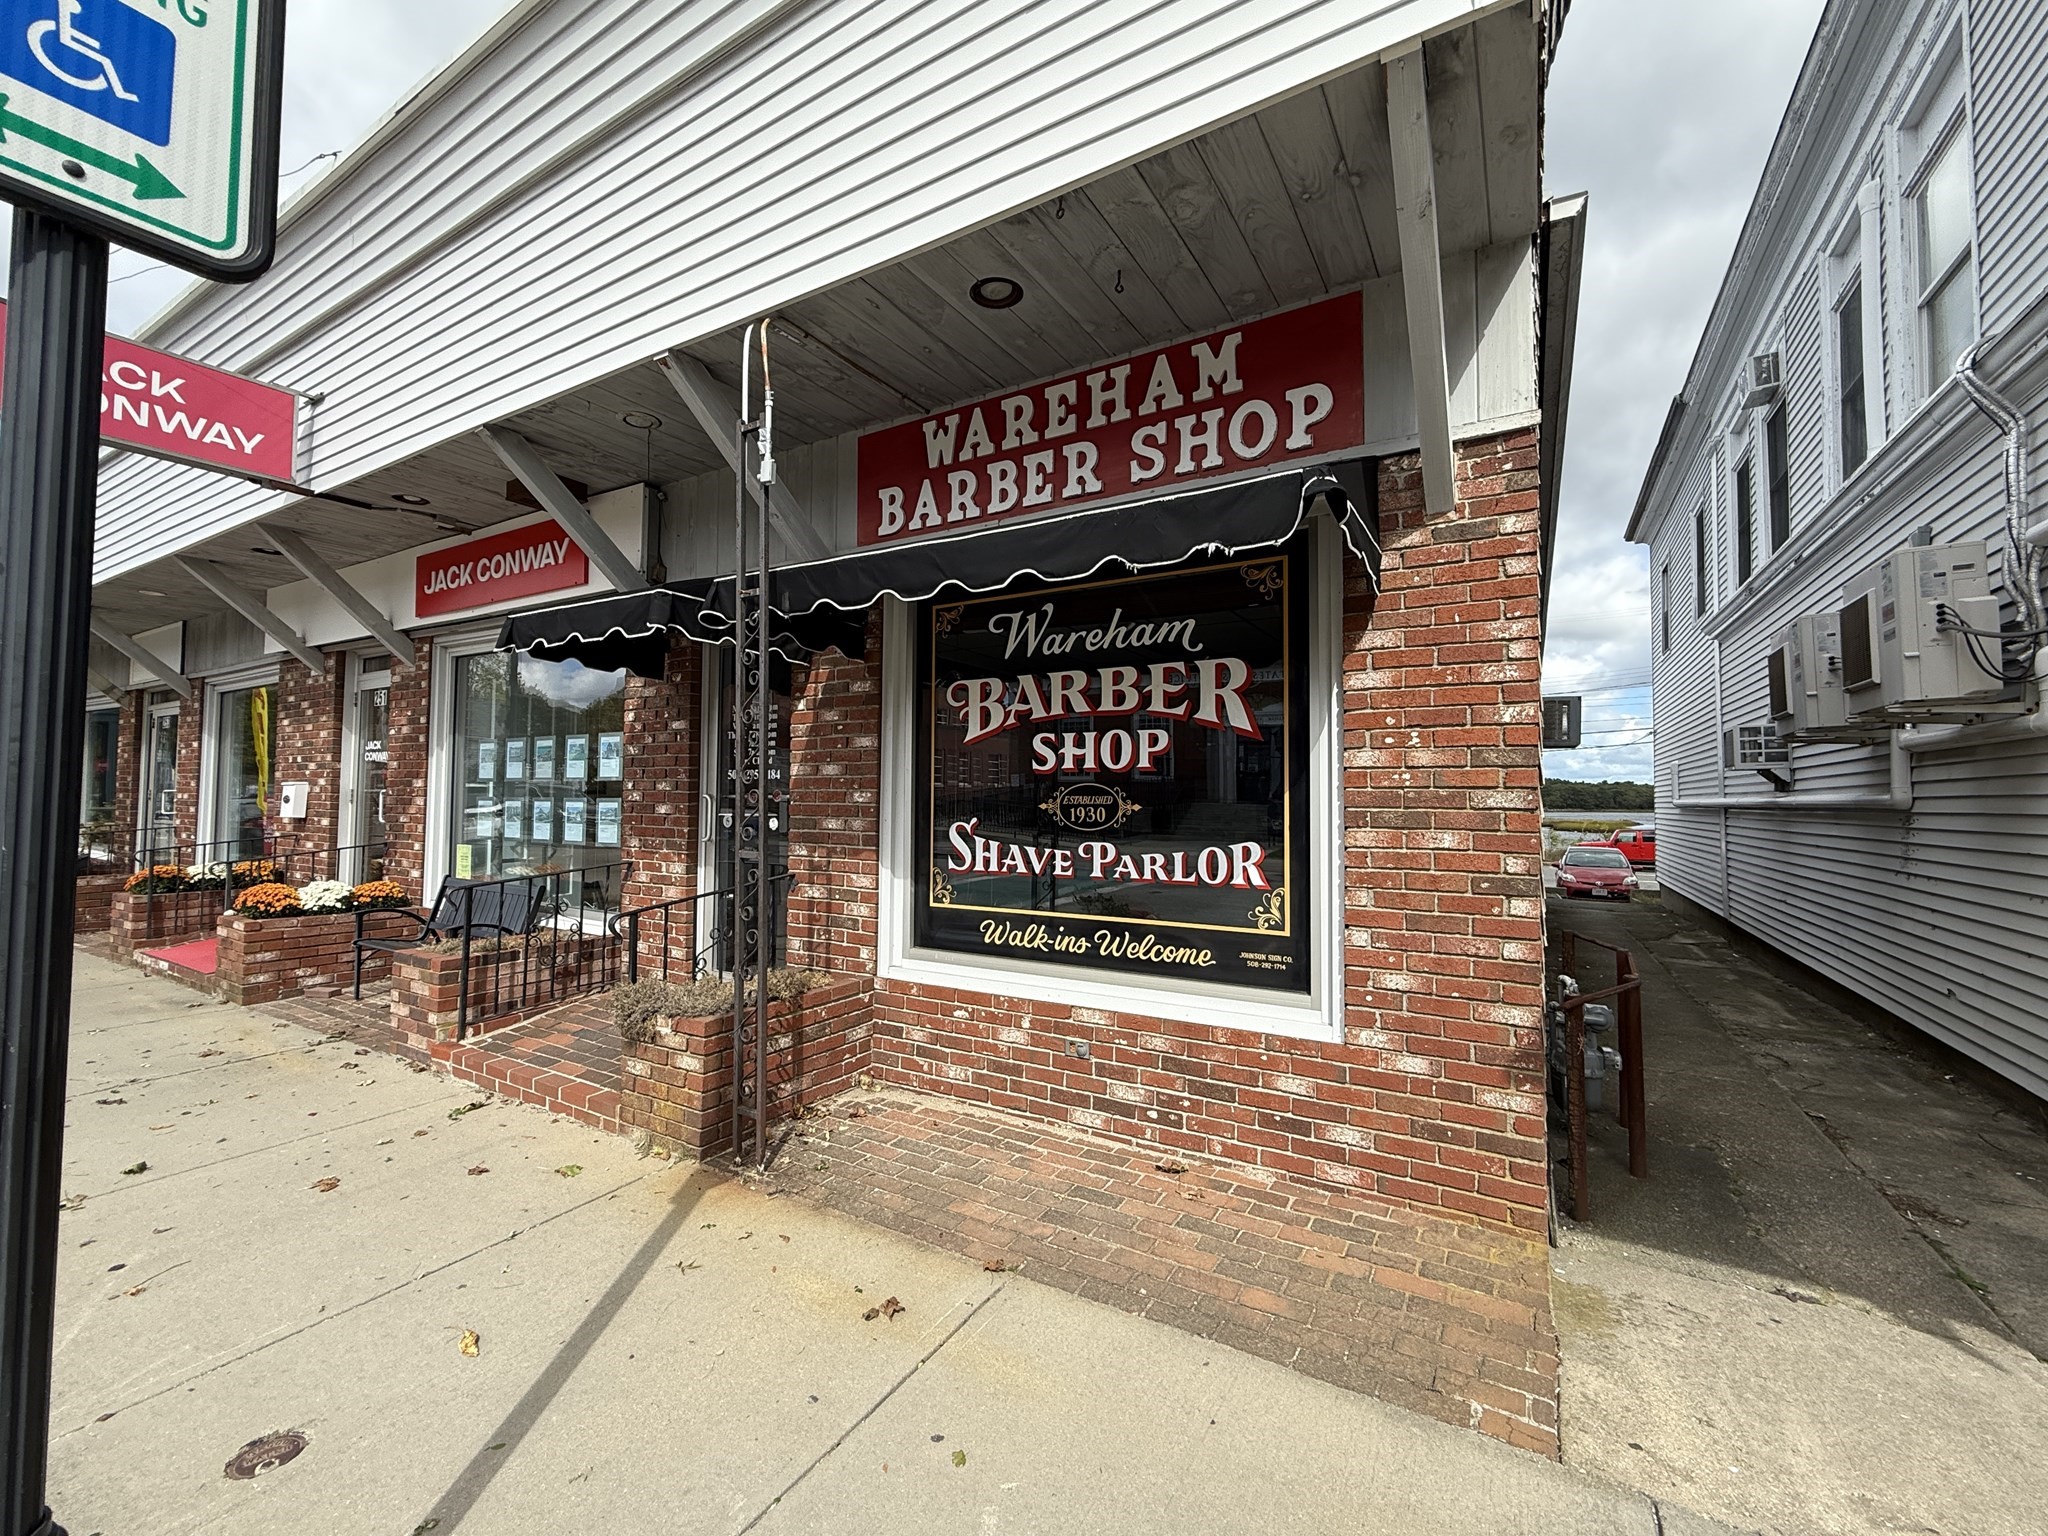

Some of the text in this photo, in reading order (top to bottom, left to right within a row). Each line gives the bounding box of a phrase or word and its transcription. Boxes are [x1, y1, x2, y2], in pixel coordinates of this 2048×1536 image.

[102, 361, 187, 404] CK
[922, 331, 1244, 469] WAREHAM
[100, 394, 266, 455] NWAY
[877, 382, 1335, 536] BARBER SHOP
[424, 537, 571, 595] JACK CONWAY
[988, 602, 1205, 660] Wareham
[375, 691, 387, 706] 251
[946, 656, 1264, 744] BARBER
[365, 741, 382, 751] JACK
[1032, 729, 1172, 774] SHOP
[1062, 795, 1114, 806] ESTABLISHED
[1069, 806, 1106, 824] 1930
[948, 817, 1272, 890] SHAVE PARLOR
[979, 919, 1217, 968] Walk-ins Welcome
[1239, 952, 1267, 961] JOHNSON
[1267, 954, 1282, 962] SIGN
[1247, 961, 1286, 970] 508-292-1714
